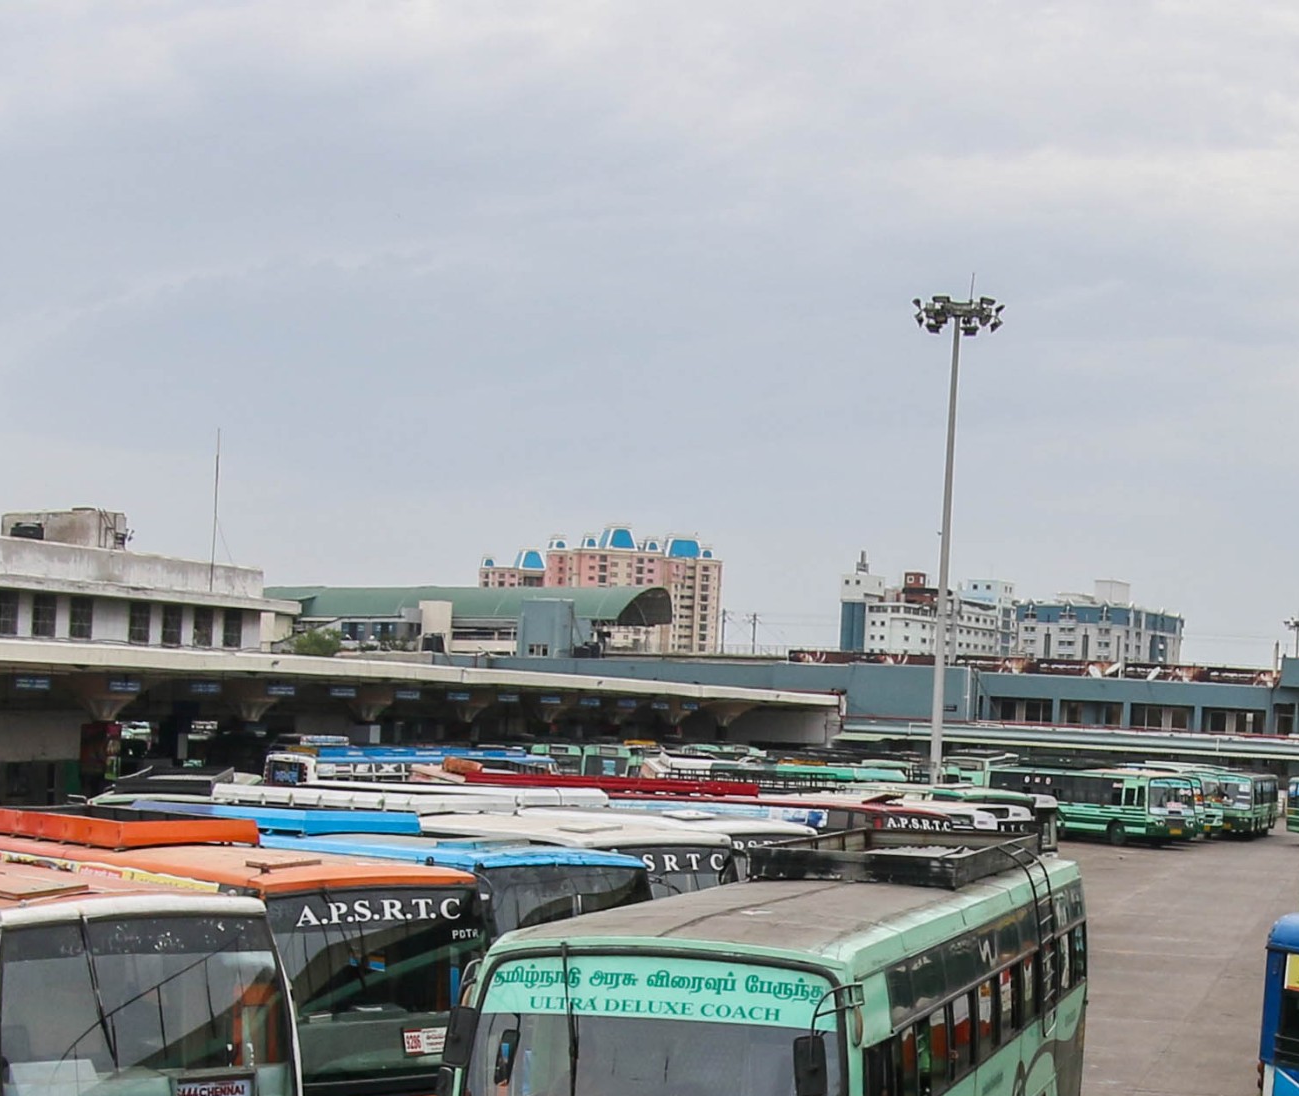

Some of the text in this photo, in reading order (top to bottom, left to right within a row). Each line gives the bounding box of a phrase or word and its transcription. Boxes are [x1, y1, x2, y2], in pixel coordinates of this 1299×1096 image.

[296, 898, 461, 927] A.P.S.R.T.C
[589, 970, 638, 987] அரசு
[530, 995, 781, 1021] ULTRA DELUXE COACH
